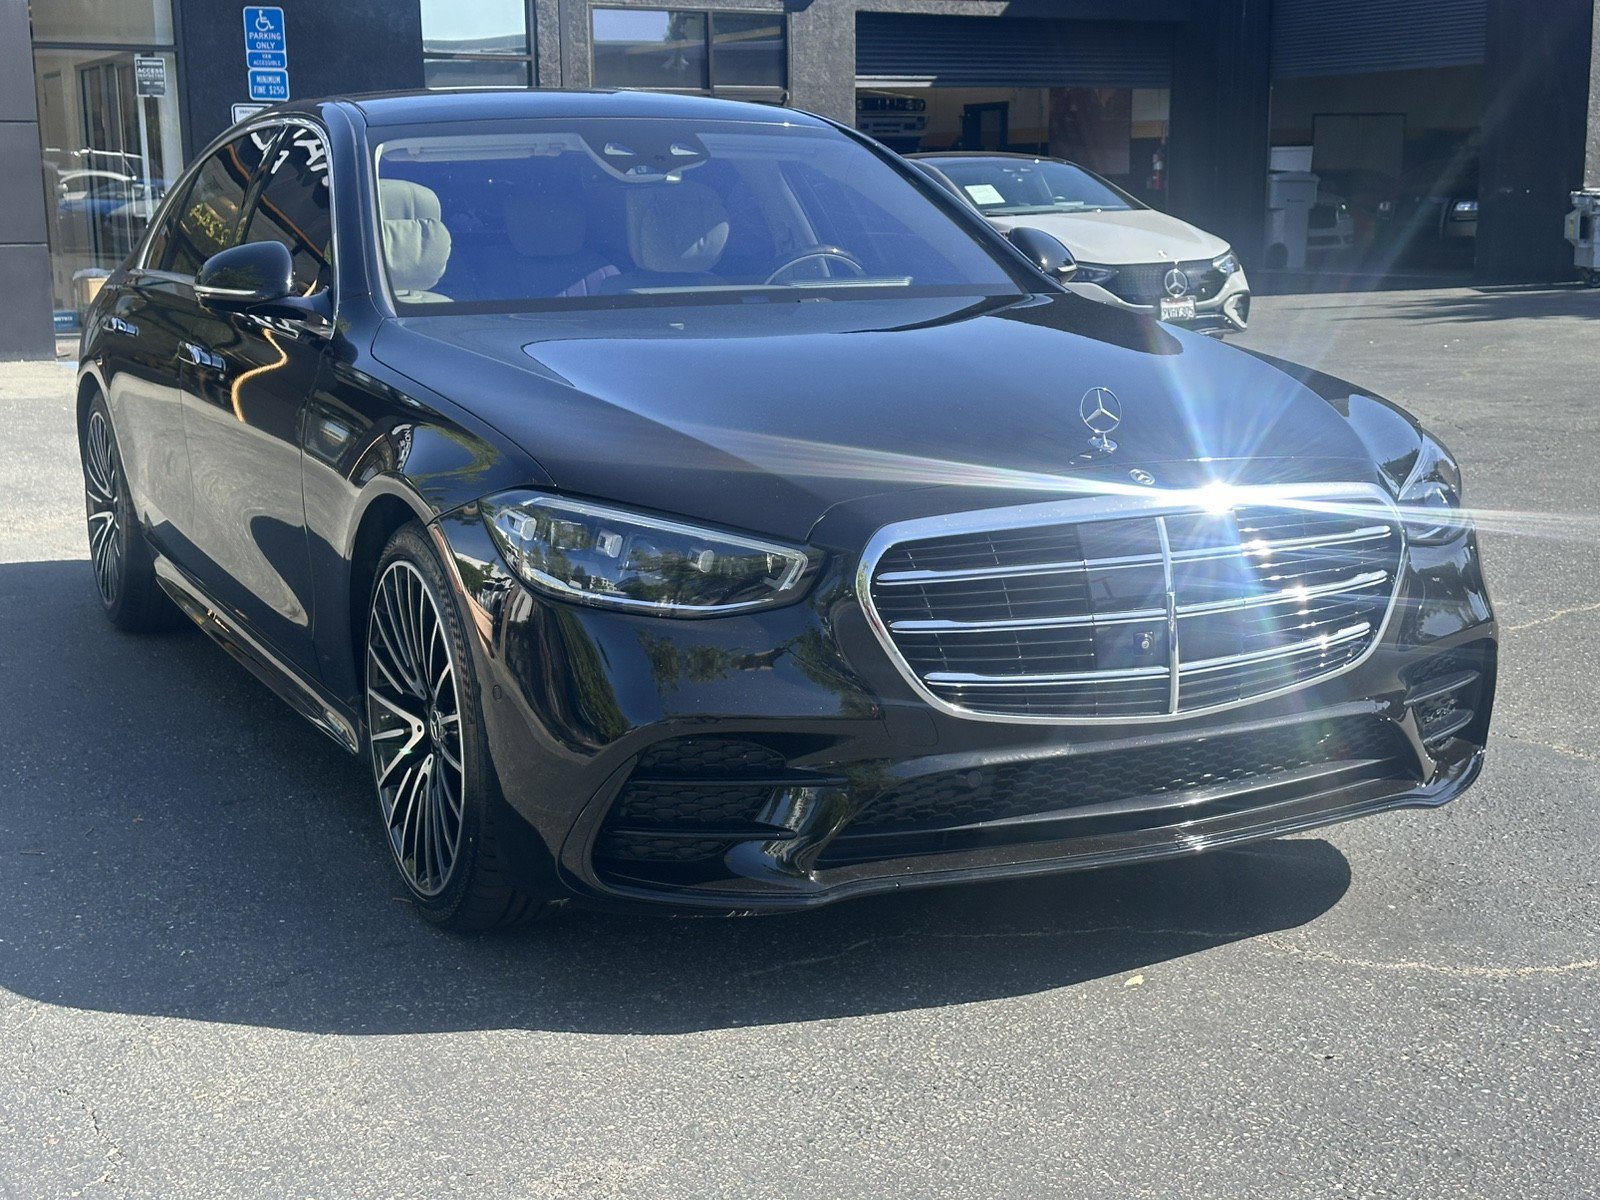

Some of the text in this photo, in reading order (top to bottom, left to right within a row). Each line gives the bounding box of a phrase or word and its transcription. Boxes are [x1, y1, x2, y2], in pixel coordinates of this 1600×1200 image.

[249, 31, 281, 40] PARKING
[255, 41, 275, 49] ONLY
[256, 75, 281, 84] MINIMUM
[253, 85, 285, 95] FINE $250
